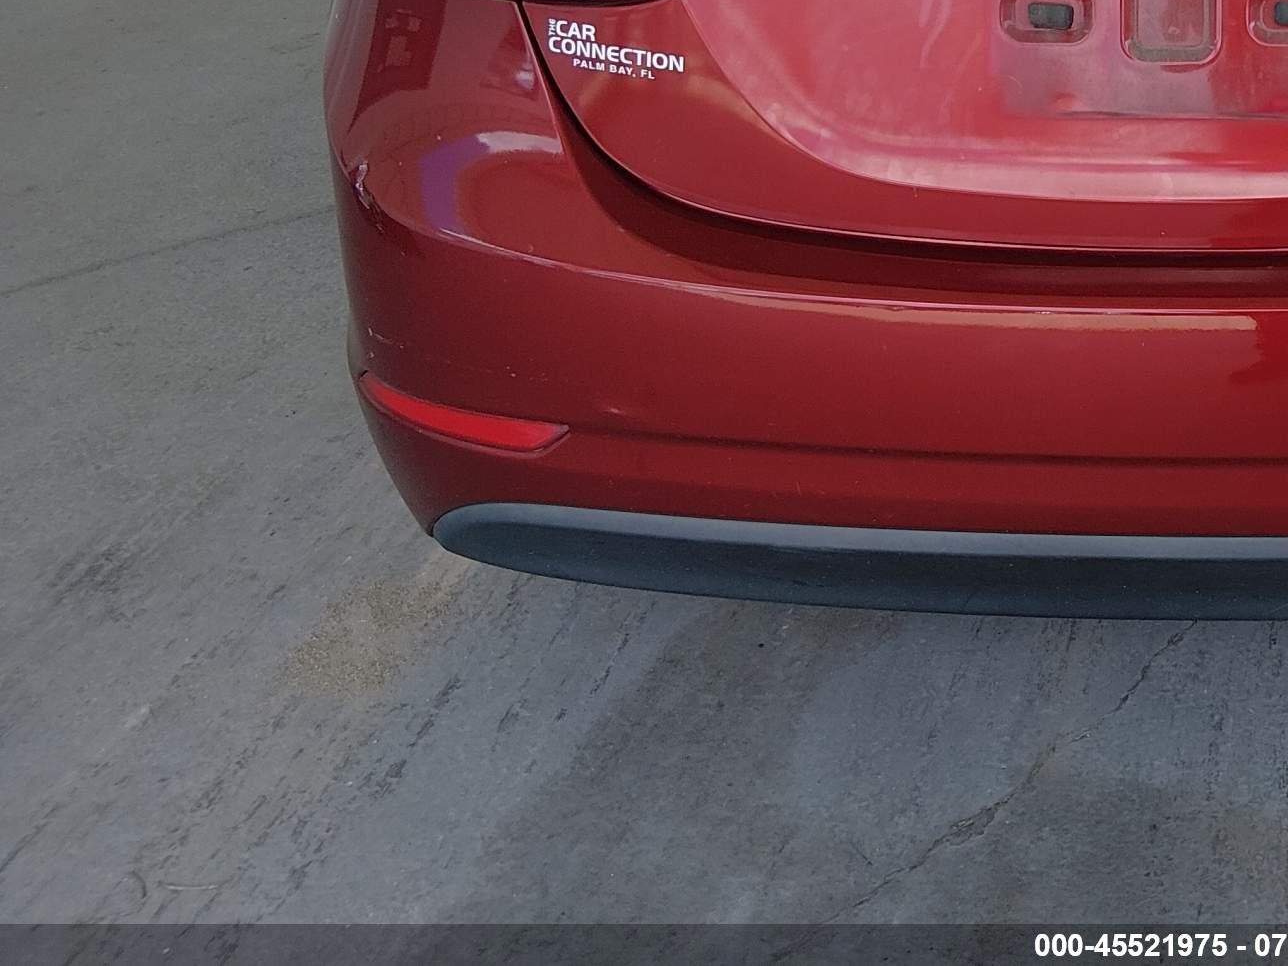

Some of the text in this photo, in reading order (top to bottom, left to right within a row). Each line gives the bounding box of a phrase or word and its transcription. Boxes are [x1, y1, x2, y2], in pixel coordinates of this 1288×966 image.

[548, 18, 596, 42] THE CAR
[548, 36, 685, 73] CONNECTION
[573, 58, 656, 80] PALM BAY, FL
